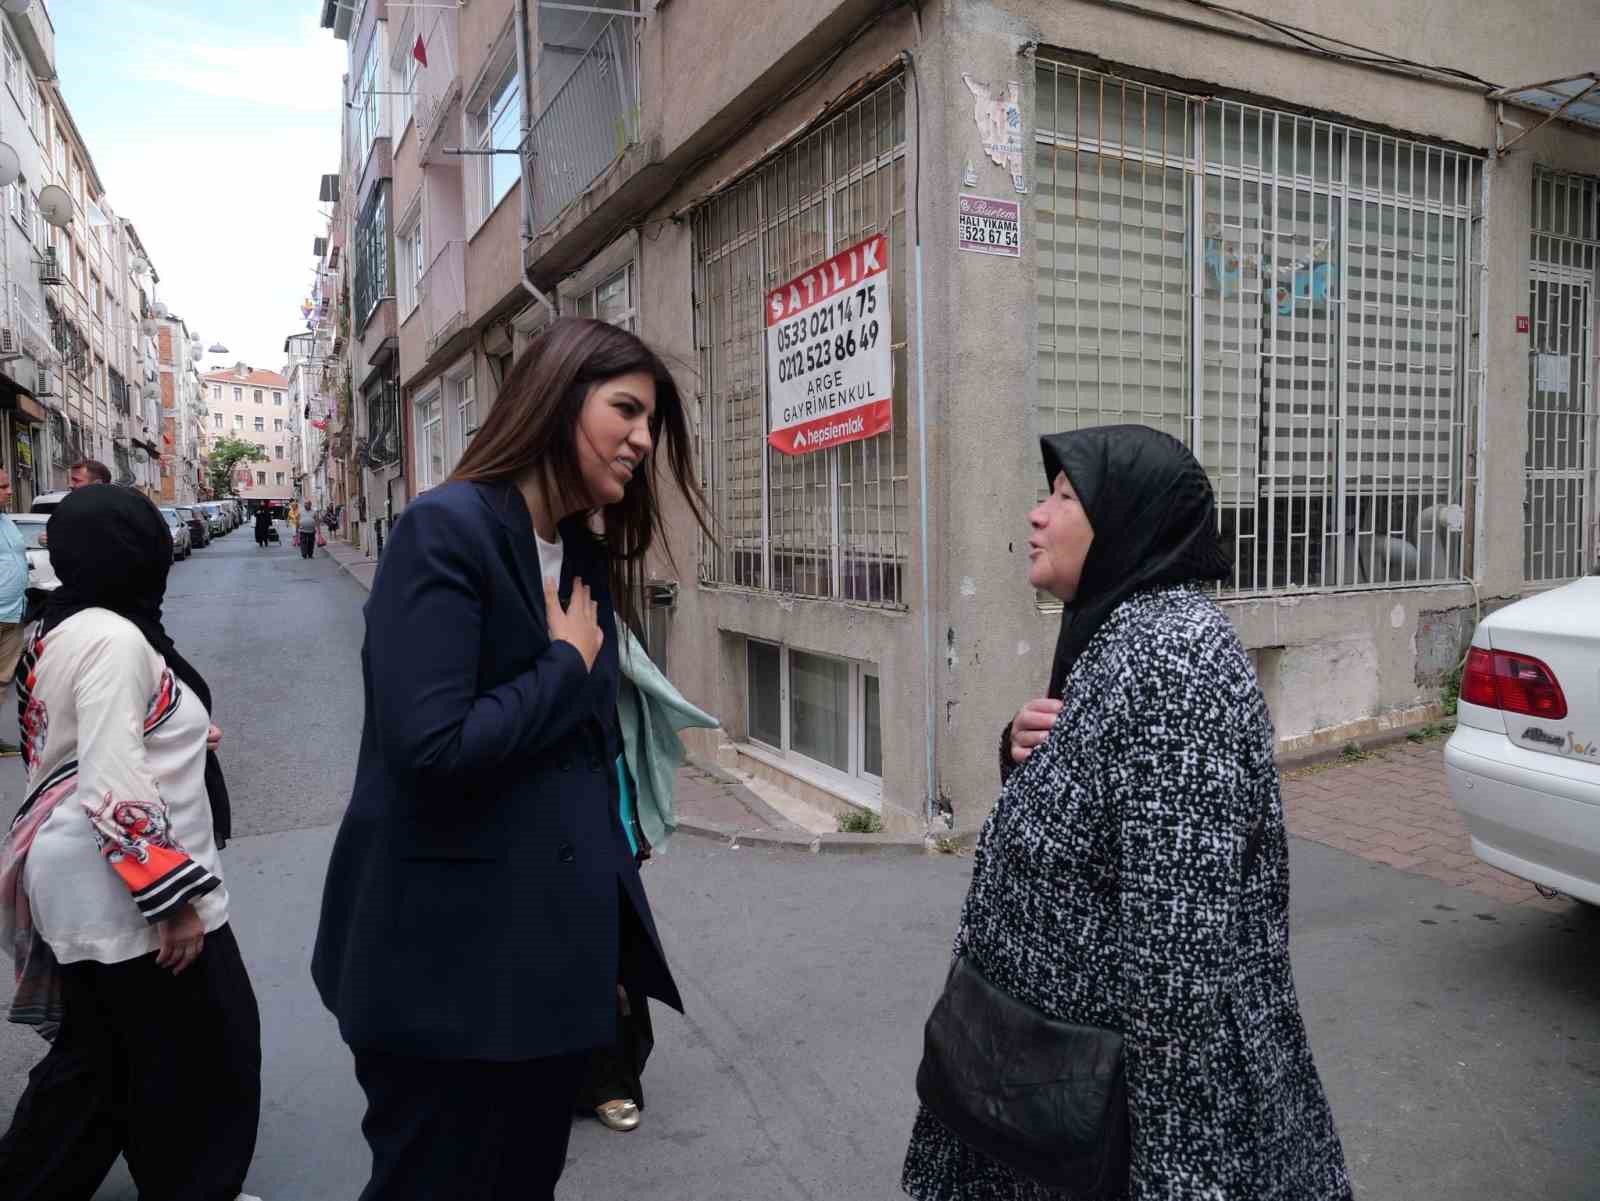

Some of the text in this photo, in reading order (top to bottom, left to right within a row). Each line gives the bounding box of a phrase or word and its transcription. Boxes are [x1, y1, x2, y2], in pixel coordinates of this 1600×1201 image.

[959, 215, 1018, 233] HALI YIKAMA
[965, 226, 985, 242] 523
[989, 229, 1001, 244] 67
[1005, 232, 1018, 247] 54
[771, 239, 880, 319] SATILIK
[777, 284, 877, 352] 0533 021 14 75
[778, 319, 879, 383] 0212 523 86 49
[807, 370, 842, 396] ARGE
[783, 381, 875, 422] GAYRİMENKUL
[807, 415, 865, 446] hepsiemlak
